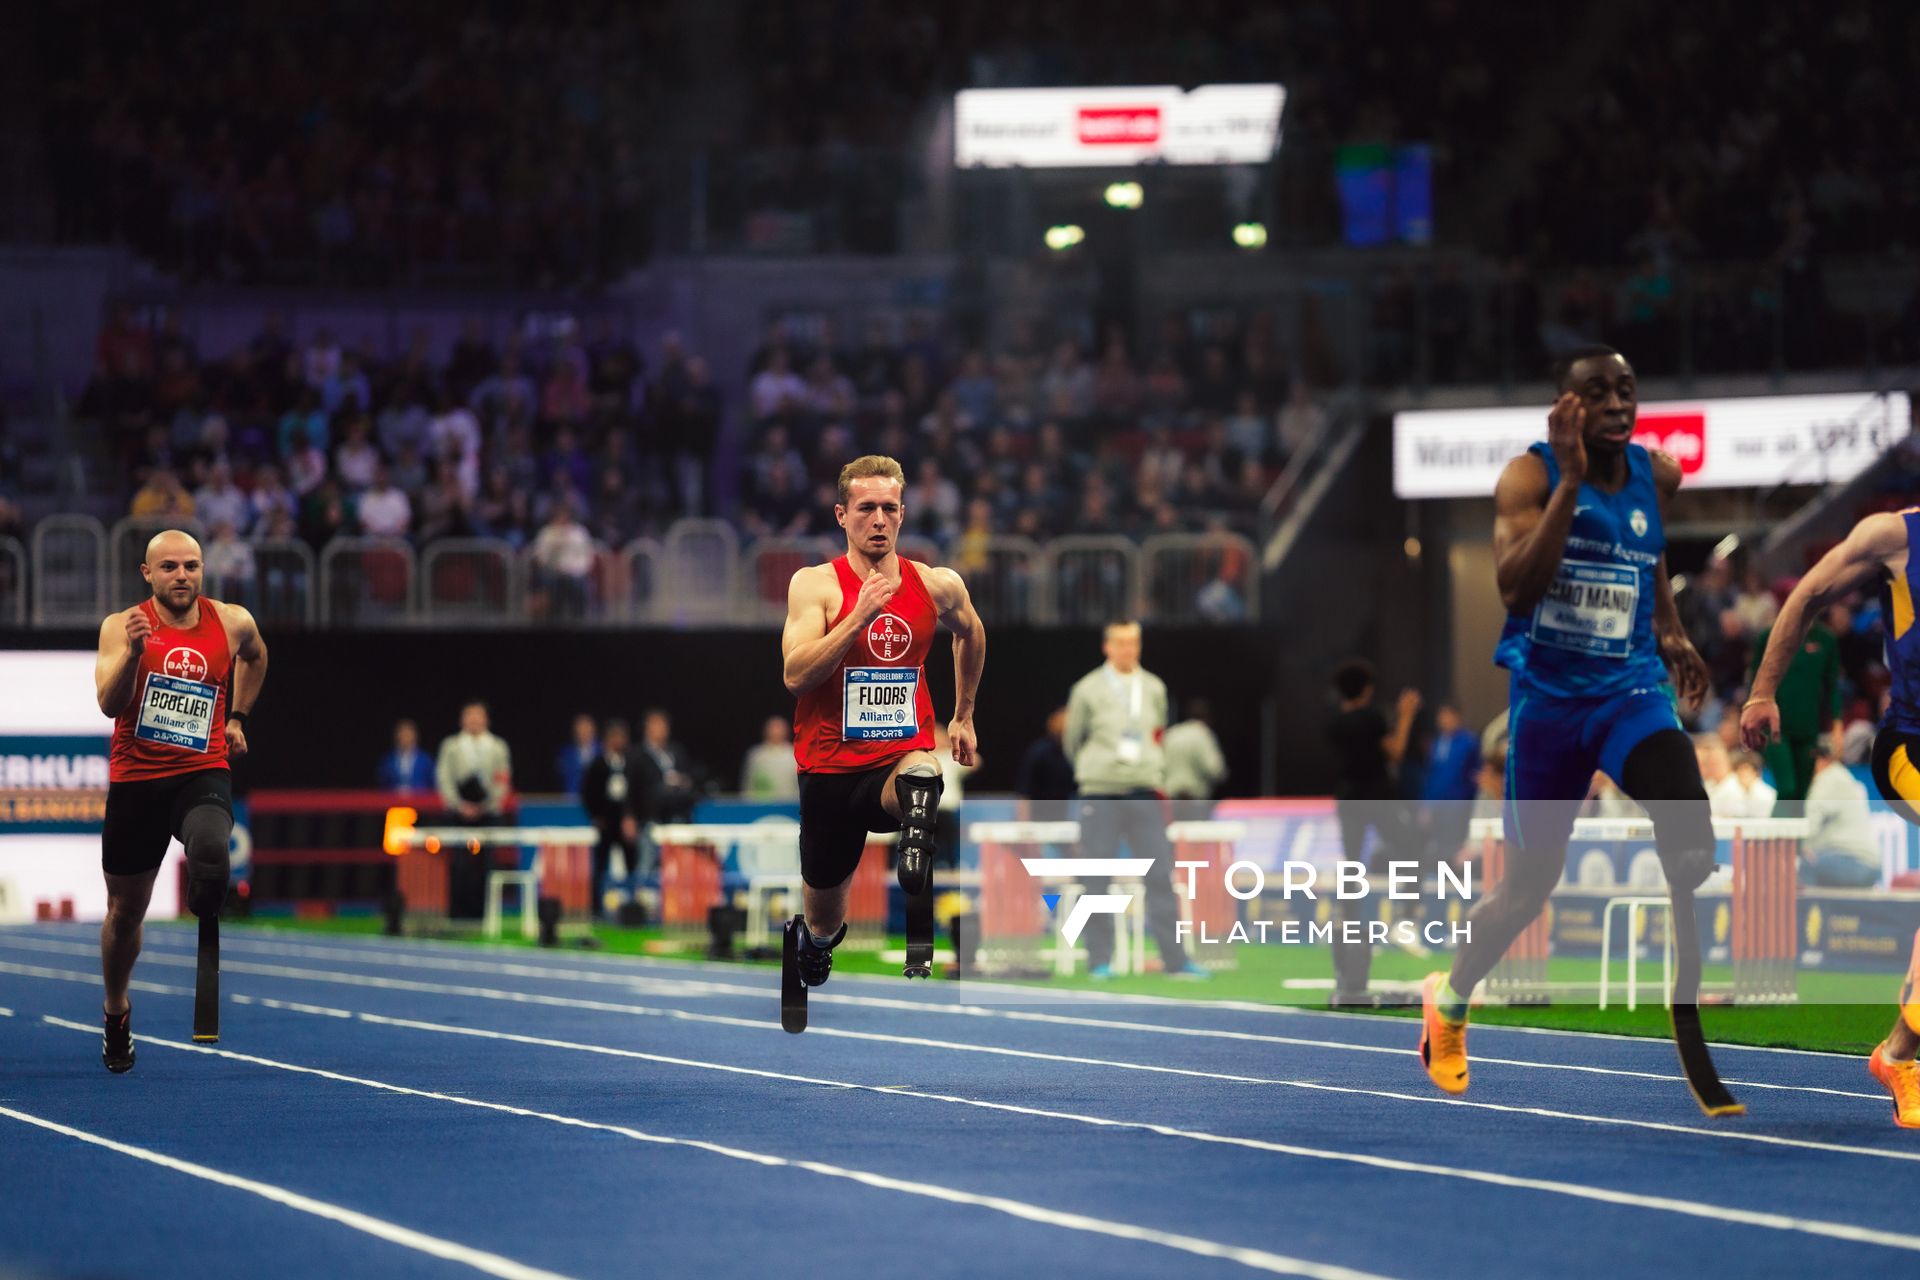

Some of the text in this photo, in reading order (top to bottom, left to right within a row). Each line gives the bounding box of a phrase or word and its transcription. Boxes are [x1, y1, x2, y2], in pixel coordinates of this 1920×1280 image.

[1586, 587, 1632, 614] MANU
[871, 633, 908, 642] BAYER
[167, 661, 204, 673] BAYER
[871, 672, 904, 681] DÜSSELDORF
[904, 672, 916, 680] 2024
[859, 686, 907, 705] FLOORS
[153, 714, 186, 729] Allianz
[859, 711, 893, 722] Allianz
[153, 730, 193, 745] D.SPORTS
[862, 729, 904, 738] D.SPORTS
